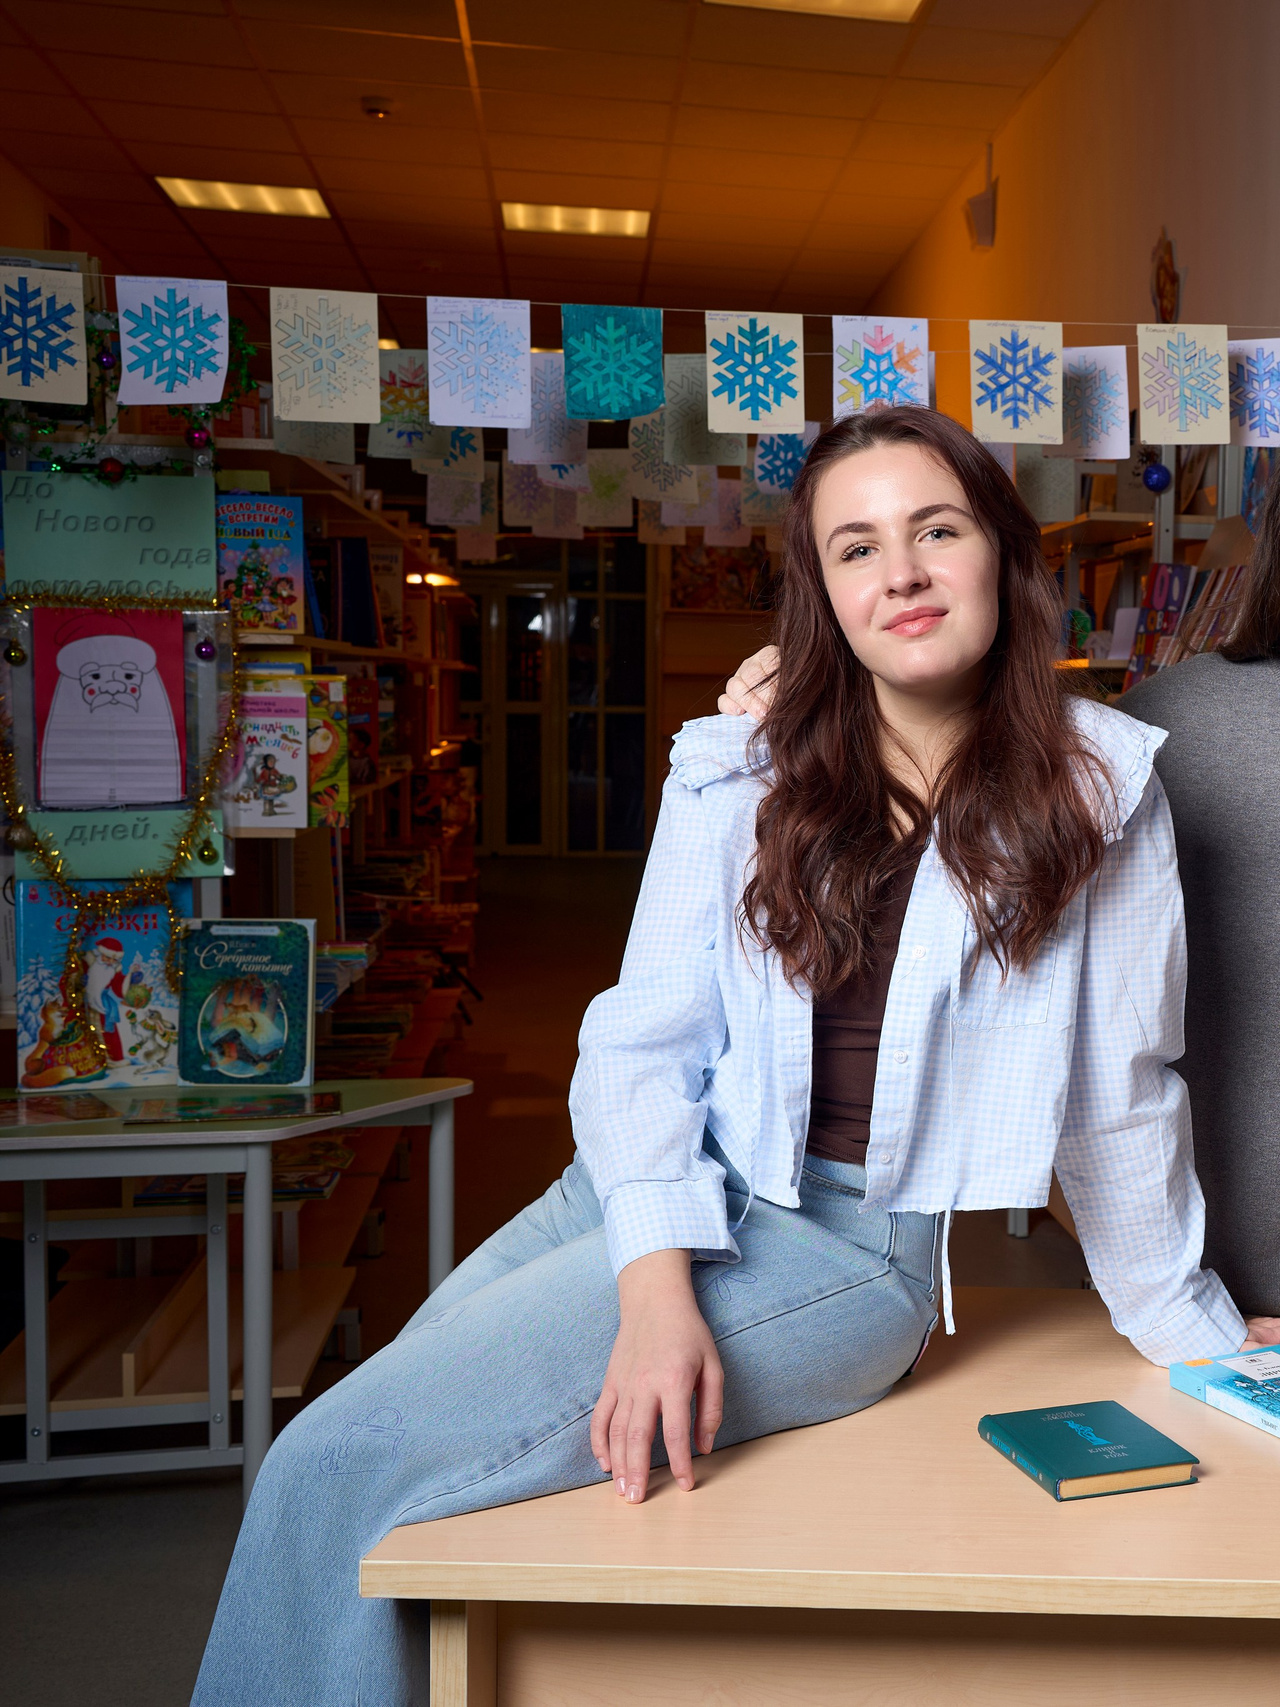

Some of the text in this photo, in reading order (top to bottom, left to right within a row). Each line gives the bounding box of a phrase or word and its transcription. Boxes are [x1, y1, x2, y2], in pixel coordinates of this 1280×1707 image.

[4, 476, 54, 504] До
[34, 508, 155, 533] Нового
[228, 513, 279, 525] ВСТРЕТИМ
[138, 547, 213, 570] года
[64, 817, 160, 847] дней.
[194, 940, 272, 971] Серебряное
[241, 963, 293, 976] копытце
[1088, 1444, 1128, 1454] КЛИНОК
